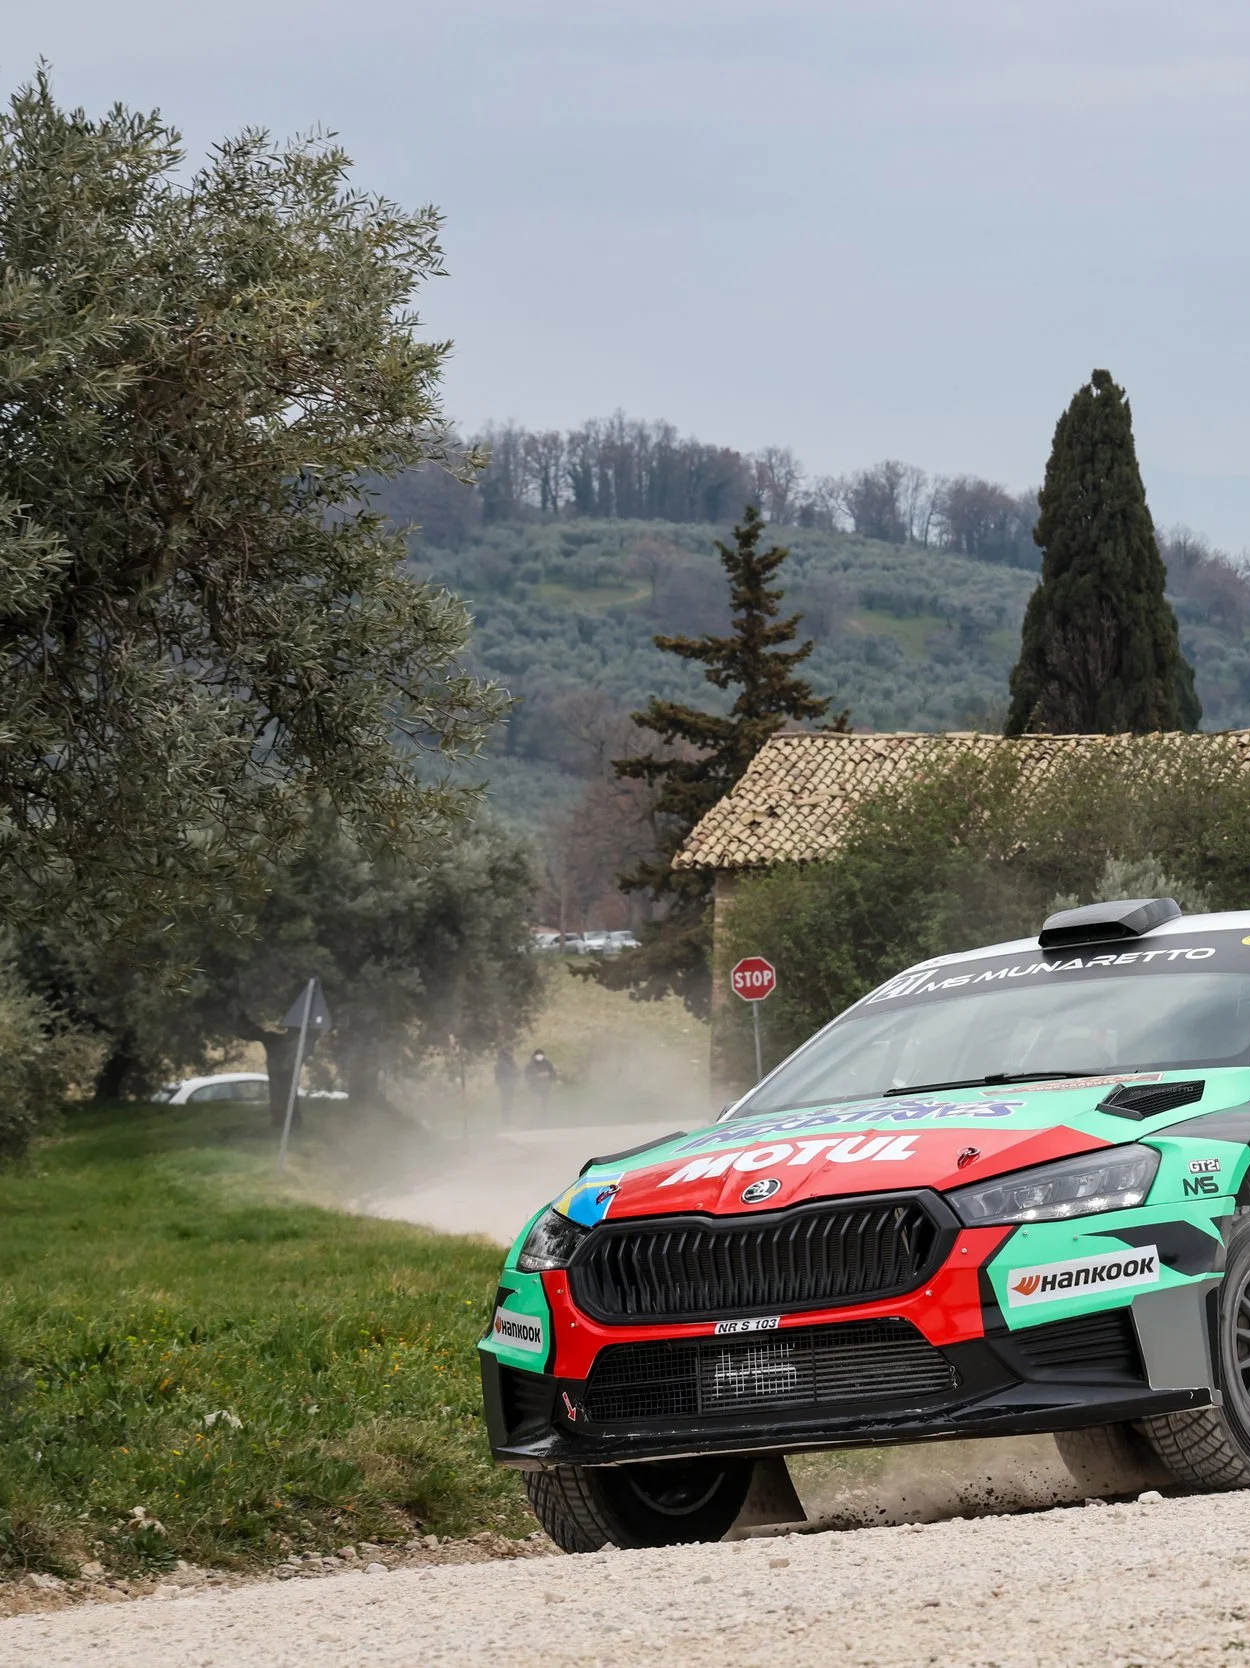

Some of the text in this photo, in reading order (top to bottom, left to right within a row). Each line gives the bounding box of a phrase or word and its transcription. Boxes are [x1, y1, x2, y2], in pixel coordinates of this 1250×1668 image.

[972, 947, 1216, 984] MUNARETTO
[735, 970, 772, 988] STOP
[656, 1135, 922, 1187] MOTUL
[1182, 1175, 1219, 1196] MS
[718, 1318, 777, 1333] NR S 103
